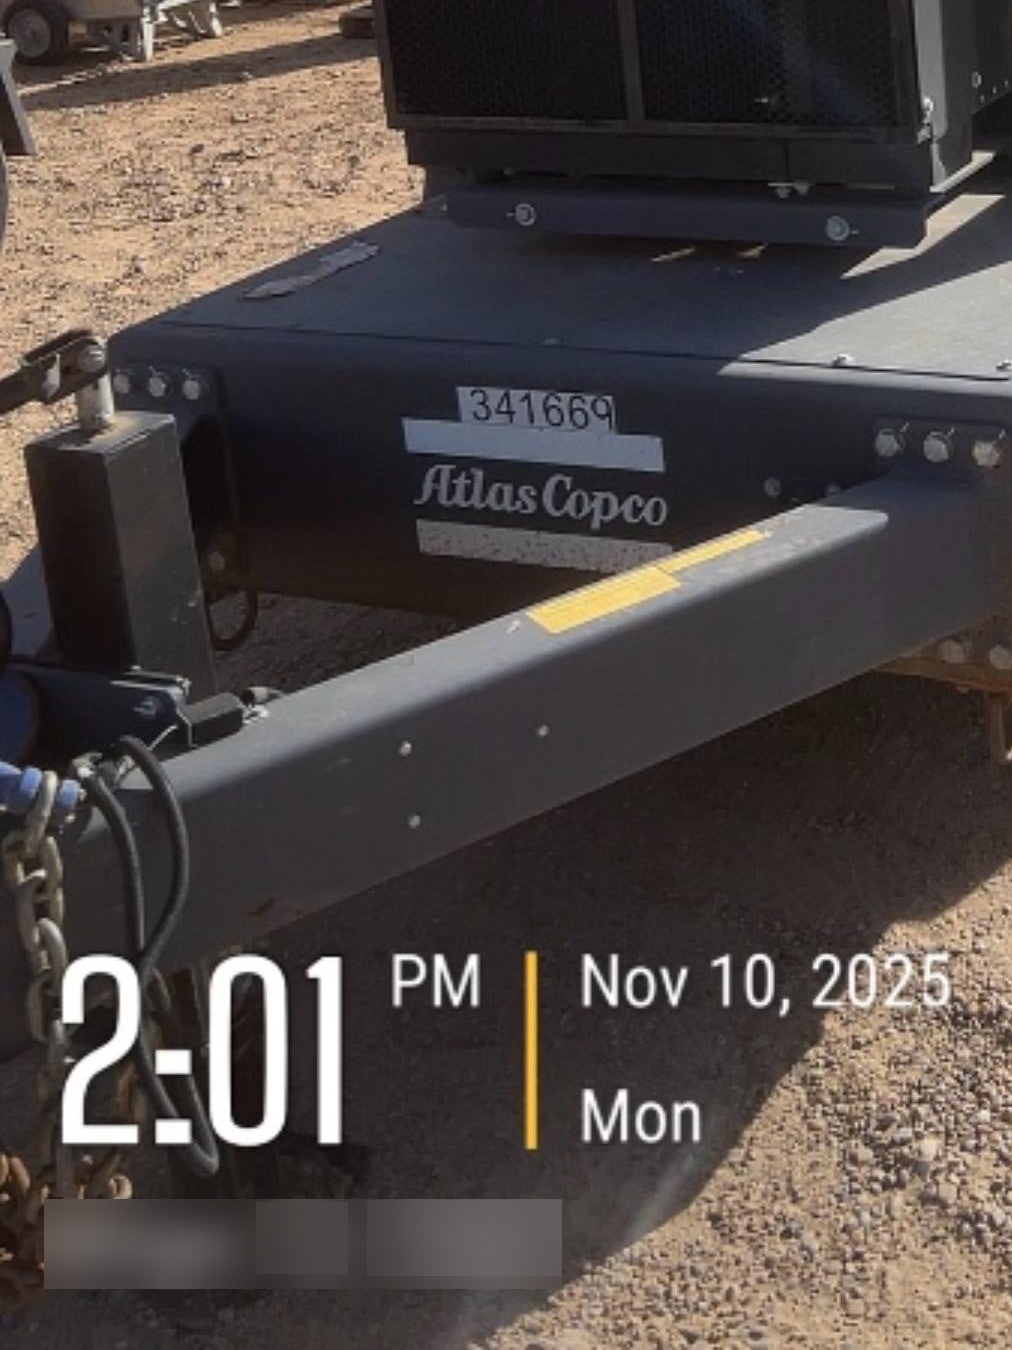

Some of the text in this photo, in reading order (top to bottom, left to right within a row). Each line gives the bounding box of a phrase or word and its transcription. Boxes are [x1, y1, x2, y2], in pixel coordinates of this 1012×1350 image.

[470, 389, 613, 431] 341669
[413, 464, 668, 531] Atlas Copco
